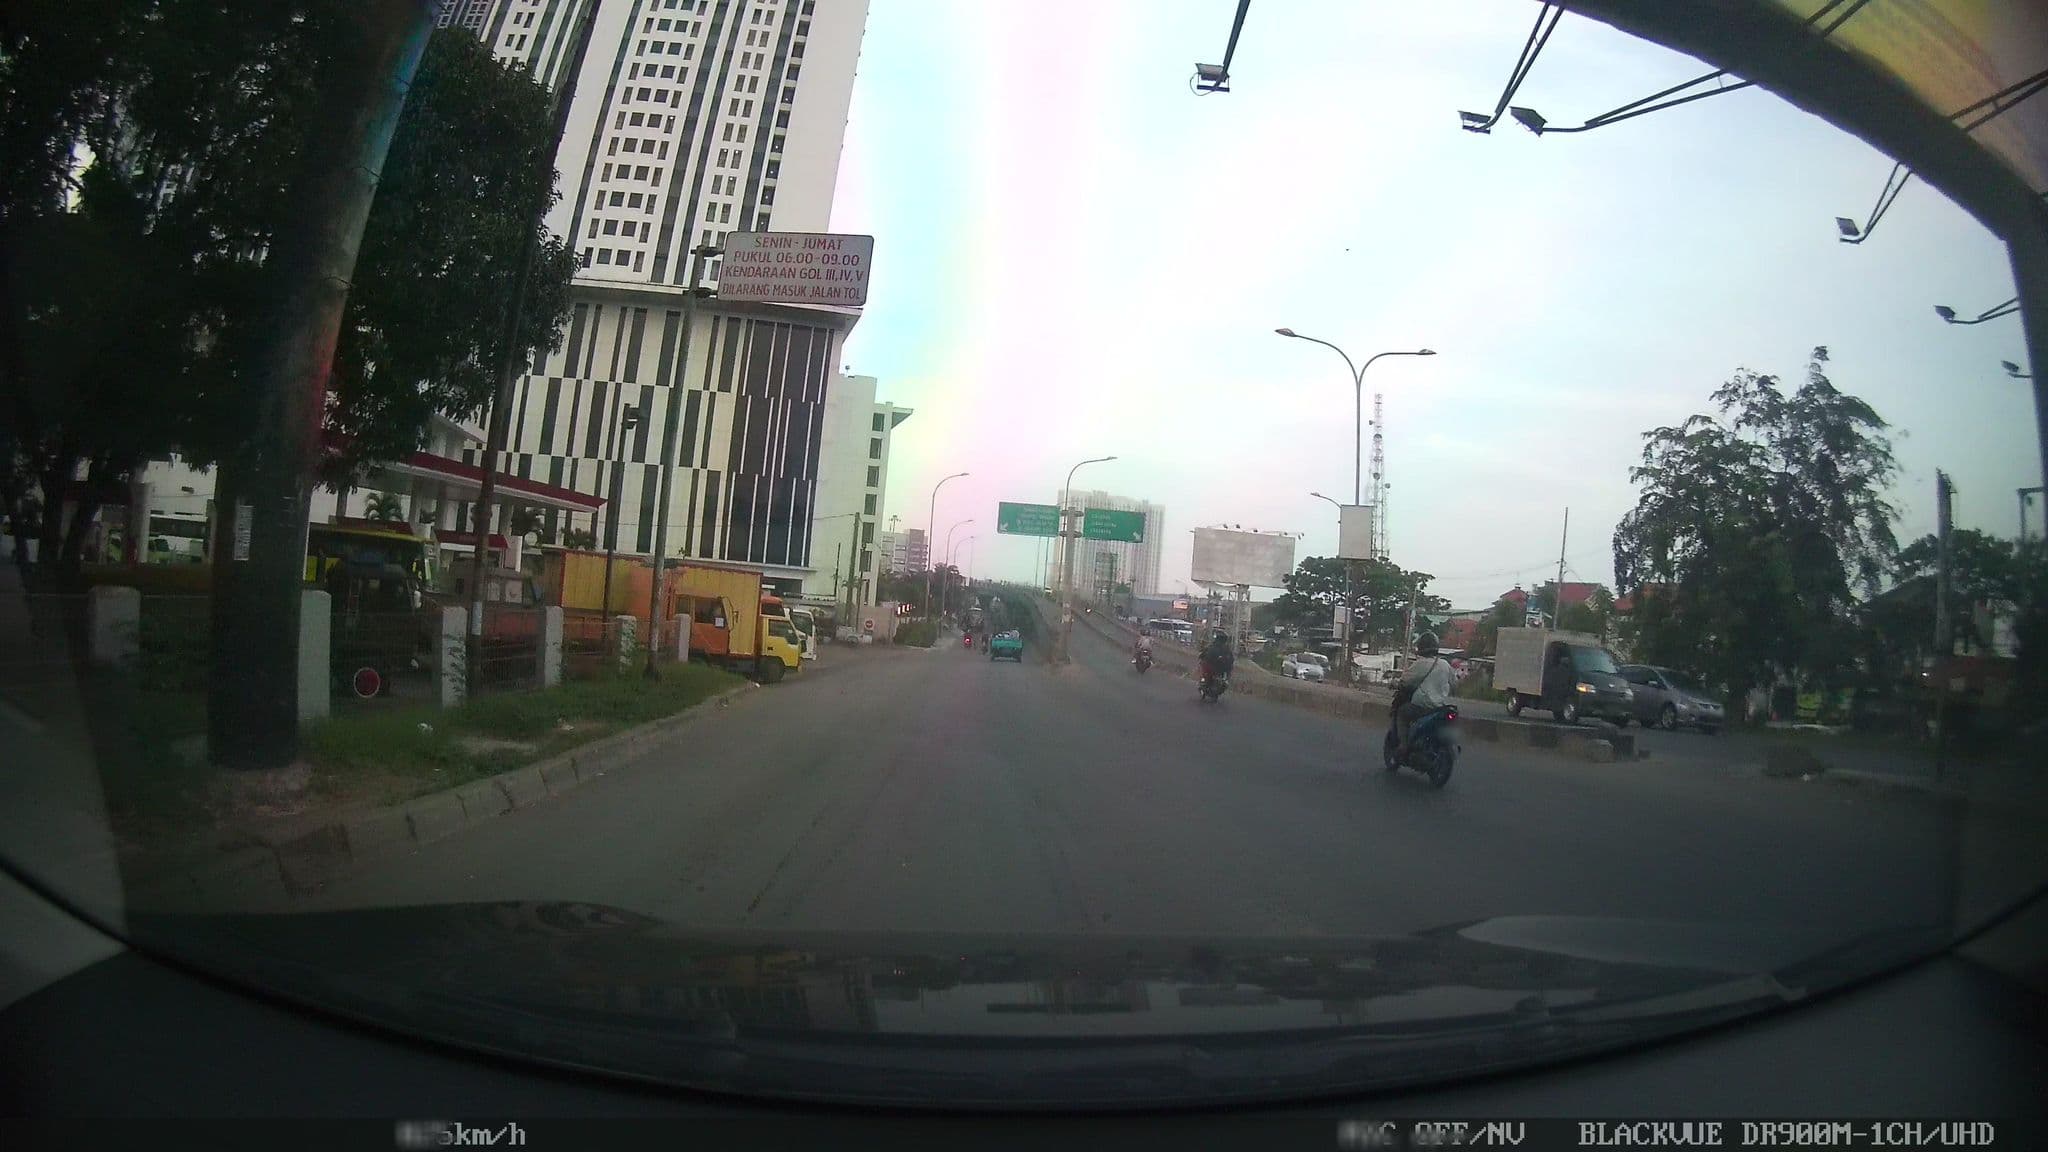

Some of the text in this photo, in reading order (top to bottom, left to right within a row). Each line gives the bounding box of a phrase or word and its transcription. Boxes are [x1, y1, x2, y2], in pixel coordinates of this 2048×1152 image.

[754, 236, 792, 248] SENIN
[802, 237, 844, 250] JUMAT
[733, 250, 772, 263] PUKUL
[725, 265, 797, 279] KENDARAAN
[799, 268, 822, 280] GOL
[722, 283, 860, 299] DILARANG MASUK JALAN TOL
